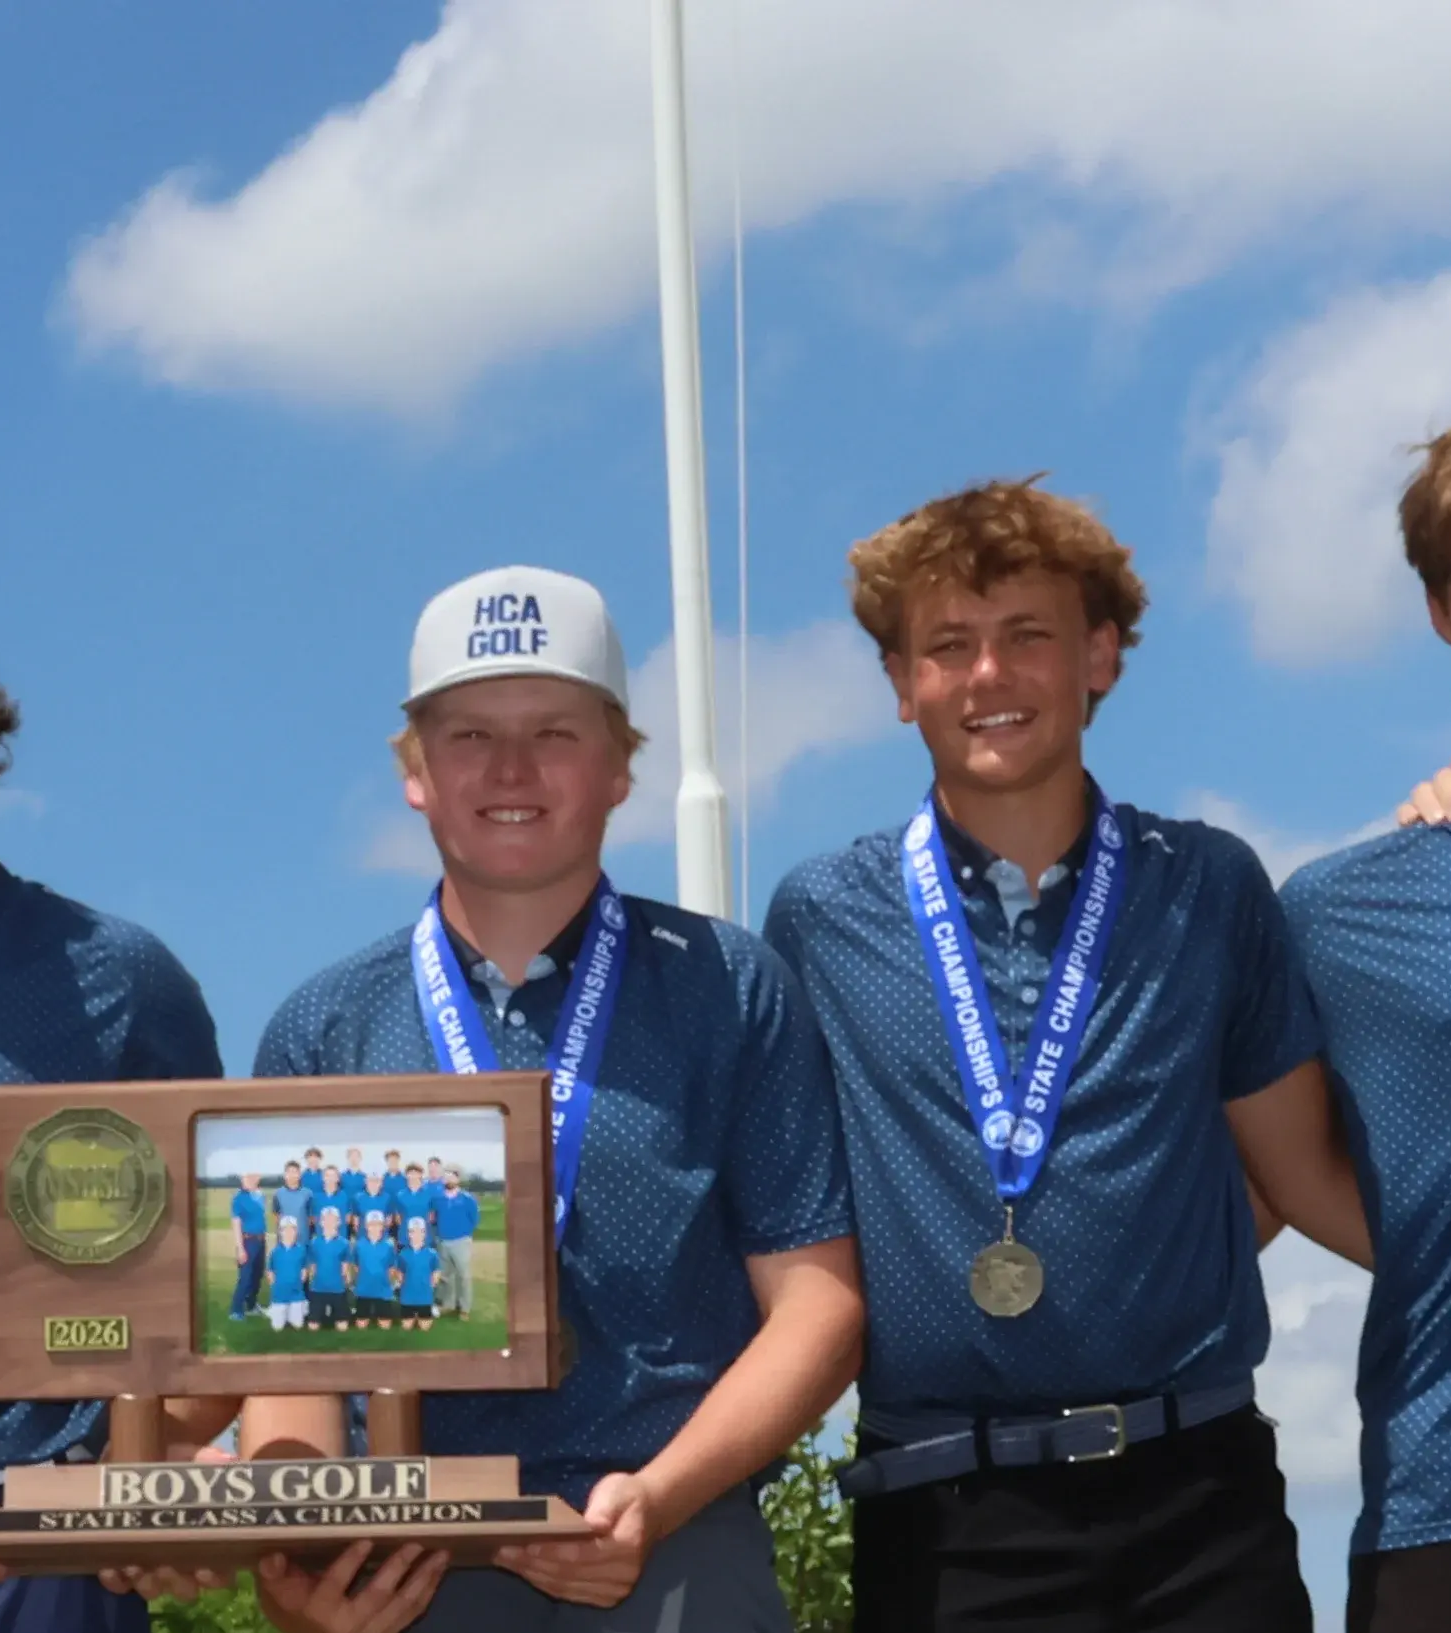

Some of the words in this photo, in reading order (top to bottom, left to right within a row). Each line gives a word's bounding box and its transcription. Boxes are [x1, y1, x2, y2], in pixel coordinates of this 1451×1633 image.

[474, 593, 543, 626] HCA
[467, 627, 548, 658] GOLF
[912, 848, 948, 917] STATE
[931, 921, 1003, 1109] CHAMPIONSHIPS
[1024, 1040, 1064, 1114] STATE
[1048, 851, 1116, 1034] CHAMPIONSHIPS
[551, 928, 617, 1102] CHAMPIONSHIPS
[54, 1320, 120, 1347] 2026
[108, 1465, 254, 1506] BOYS
[270, 1462, 426, 1502] GOLF
[39, 1510, 142, 1530] STATE
[151, 1507, 258, 1527] CLASS
[266, 1506, 289, 1525] A
[295, 1503, 482, 1525] CHAMPION
